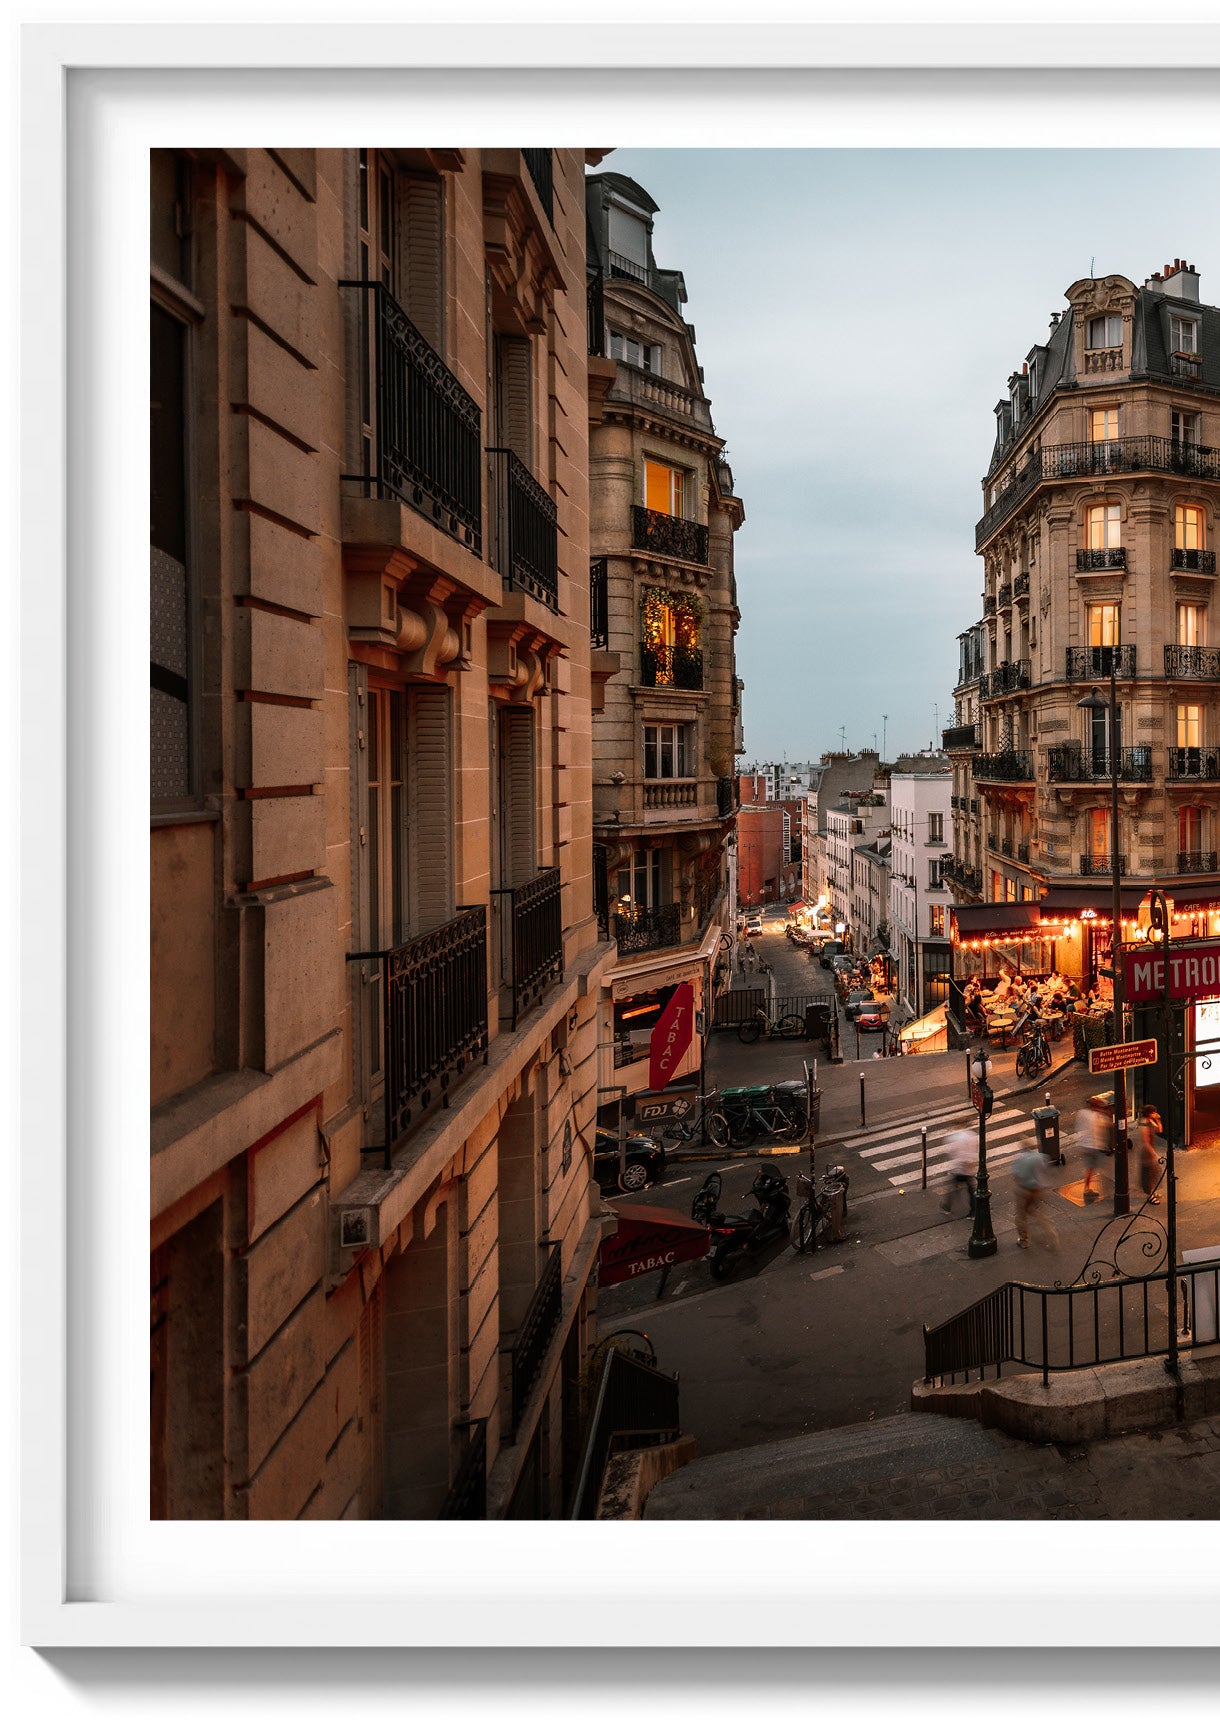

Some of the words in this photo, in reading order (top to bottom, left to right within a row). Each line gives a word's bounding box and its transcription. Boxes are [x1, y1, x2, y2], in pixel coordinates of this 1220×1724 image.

[659, 1006, 686, 1070] TABAC
[643, 1104, 669, 1119] FDJ
[628, 1251, 675, 1275] TABAC
